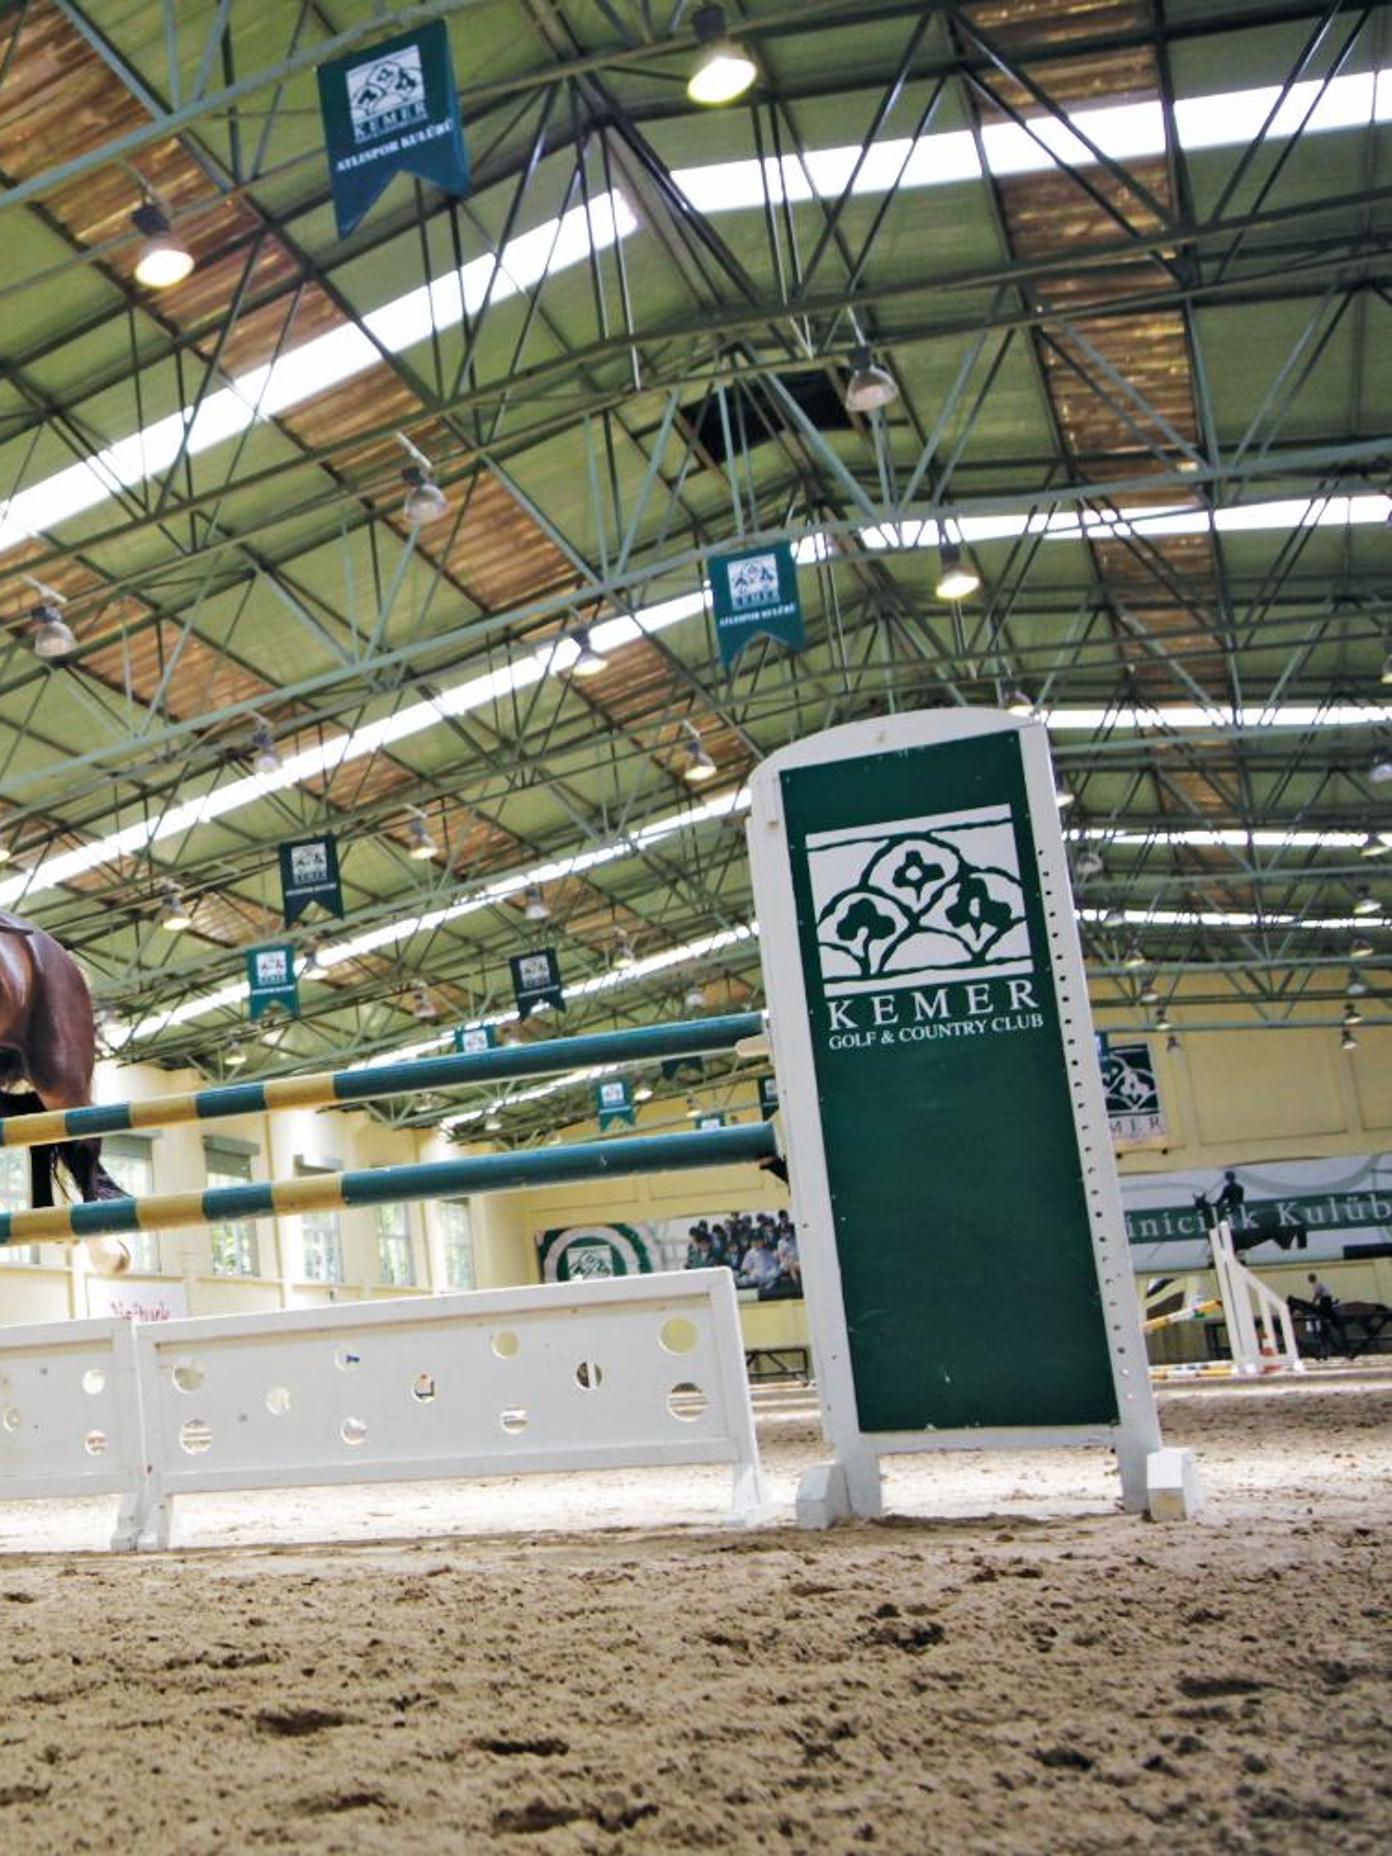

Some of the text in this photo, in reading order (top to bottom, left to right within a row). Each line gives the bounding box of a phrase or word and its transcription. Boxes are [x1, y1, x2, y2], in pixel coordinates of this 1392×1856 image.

[355, 101, 428, 138] KEMER
[826, 979, 1039, 1031] KEMER
[829, 1013, 1044, 1050] GOLF & COUNTRY CLUB
[1109, 1115, 1164, 1133] MER
[1125, 1203, 1260, 1238] inicilik
